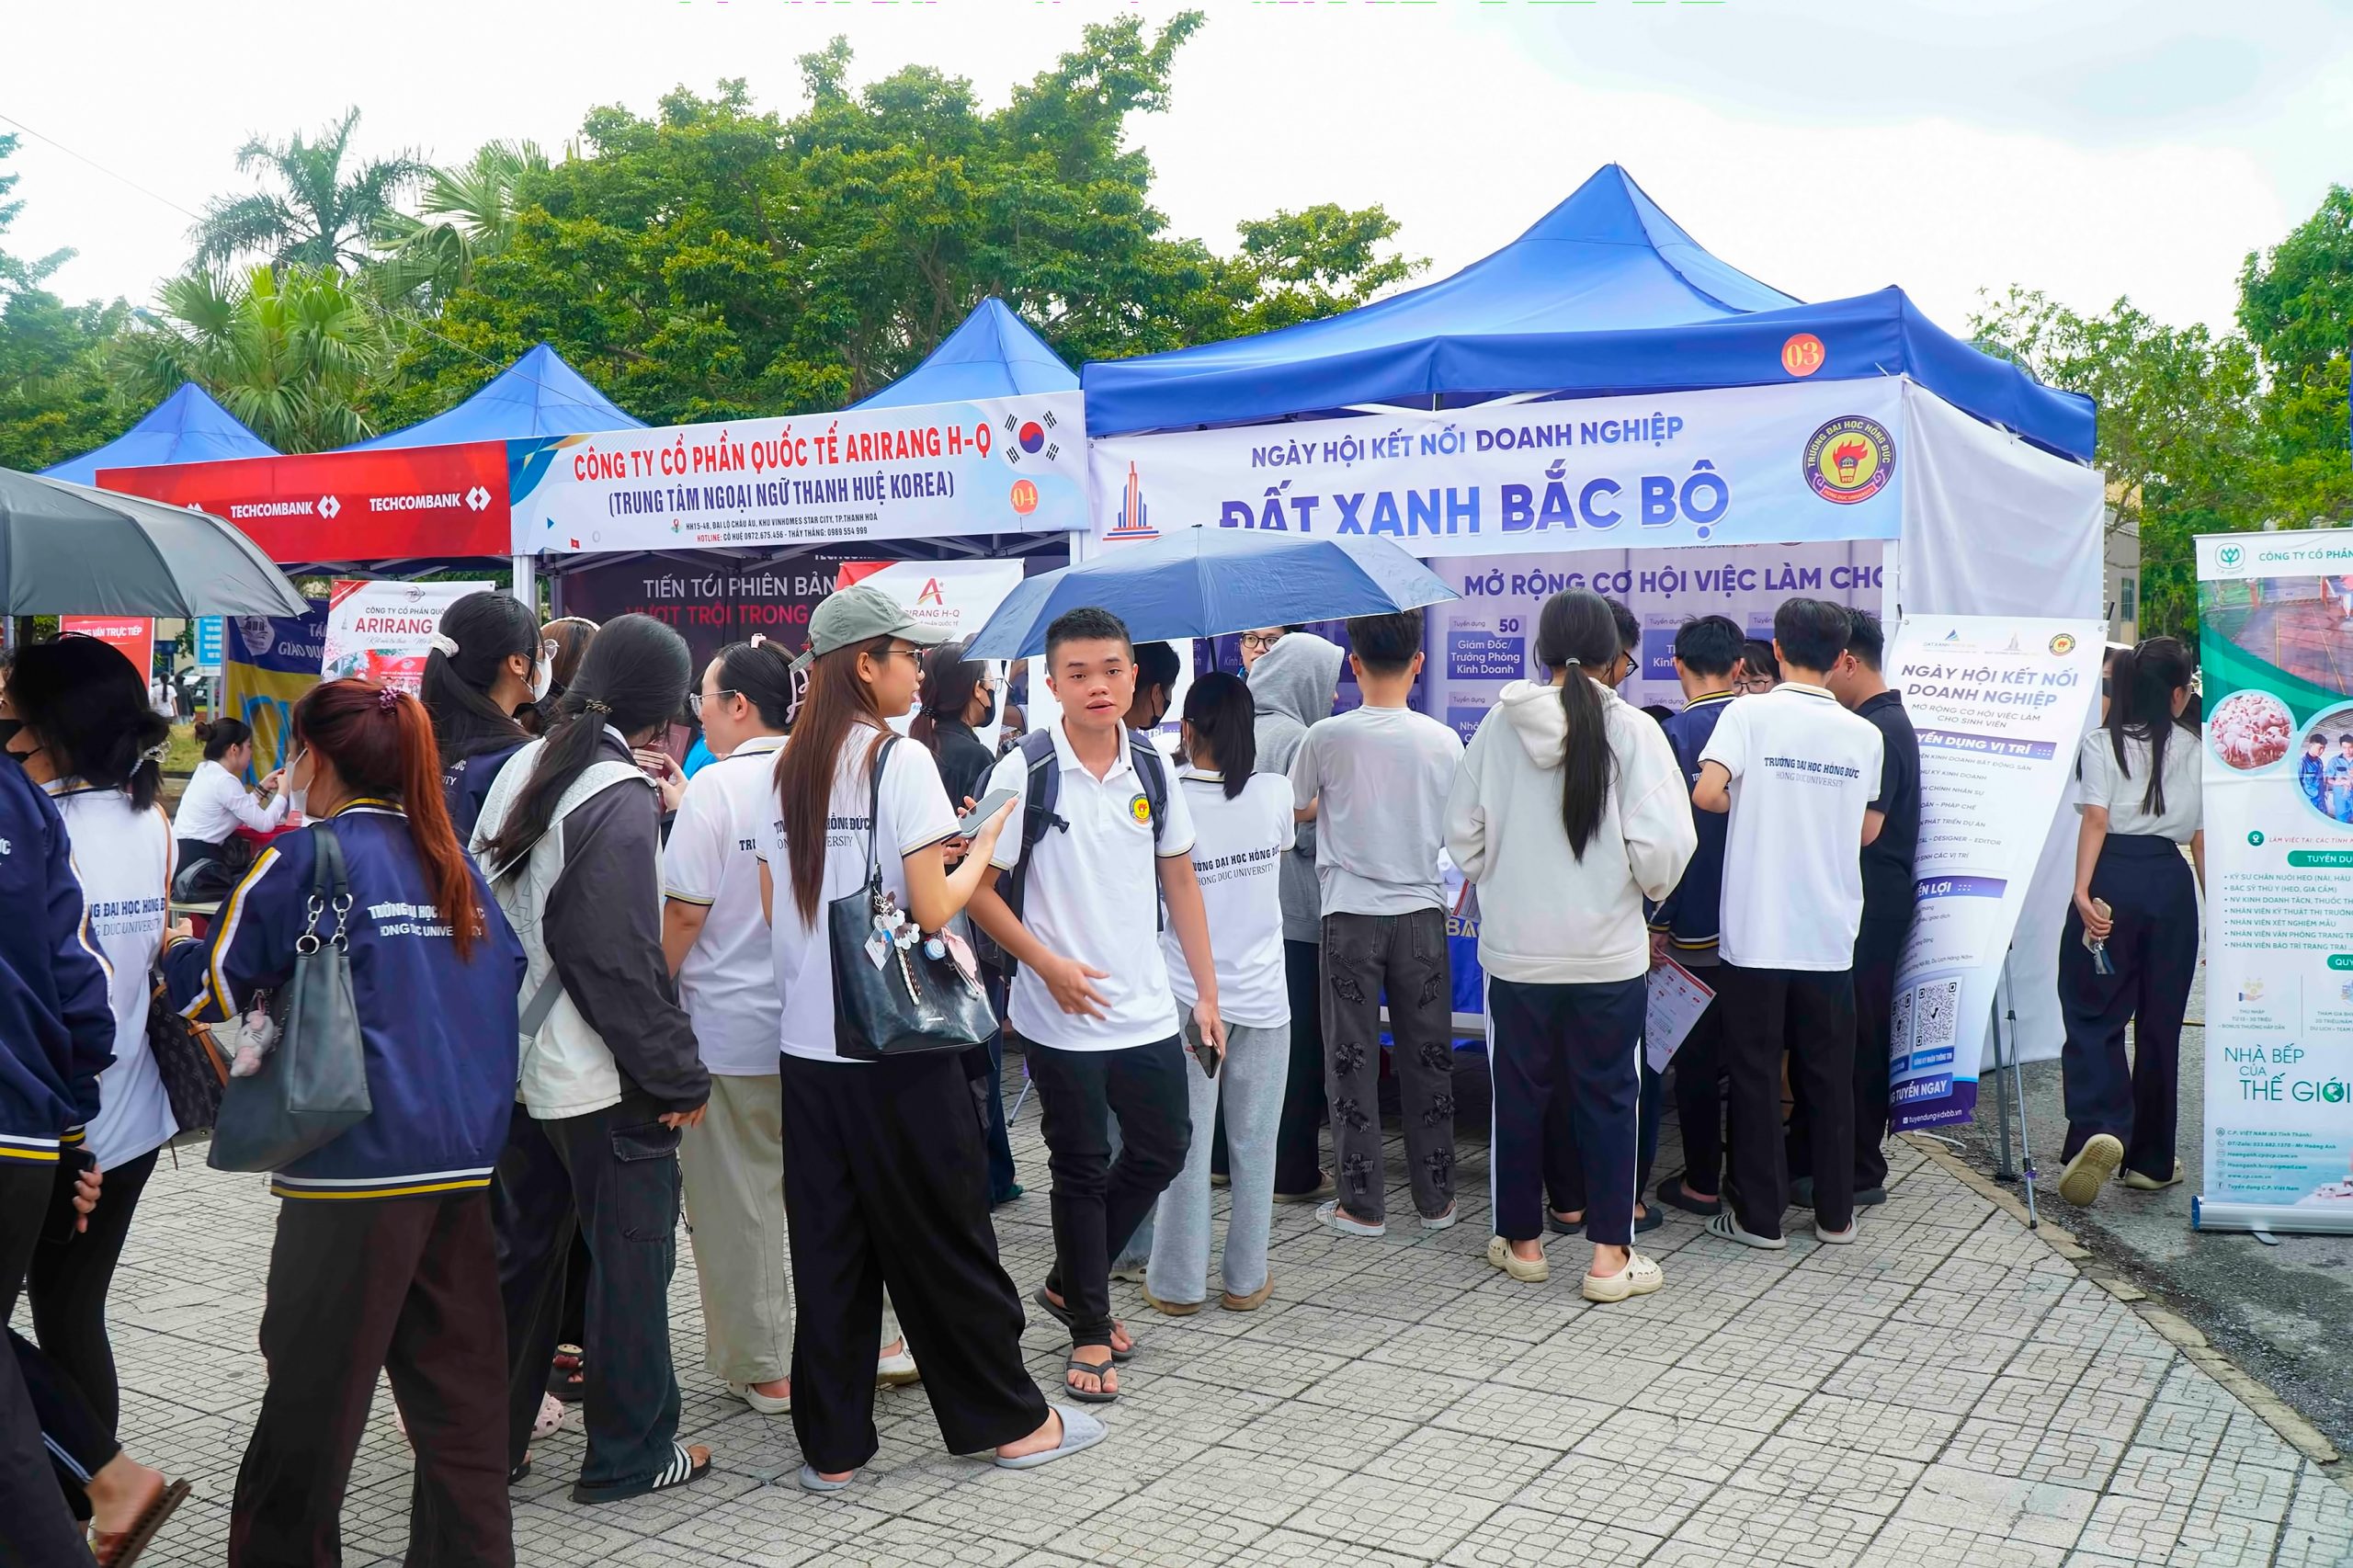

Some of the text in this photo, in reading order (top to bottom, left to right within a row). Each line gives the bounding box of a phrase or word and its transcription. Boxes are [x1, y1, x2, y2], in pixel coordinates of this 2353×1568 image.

[1787, 341, 1820, 369] 03
[1844, 420, 1864, 430] HỌC
[1252, 411, 1684, 468] NGÀY HỘI KẾT NỐI DOANH NGHIỆP
[574, 420, 992, 482] CÔNG TY CỔ PHẦN QUỐC TẾ ARIRANG H-Q
[608, 470, 953, 517] (TRUNG TÂM NGOẠI NGỮ THANH HUỆ KOREA)
[1013, 487, 1037, 507] 04
[1219, 458, 1730, 540] ĐẤT XANH BẮC BỘ
[231, 501, 313, 518] TECHCOMBANK
[369, 493, 460, 512] TECHCOMBANK
[758, 513, 864, 527] KHU VINHOMES STAR CITY, TP.THANH
[697, 533, 722, 543] HOTLINE:
[856, 526, 868, 535] 999
[2258, 551, 2290, 562] CÔNG
[2291, 551, 2305, 561] TY
[2308, 548, 2324, 560] CỔ
[643, 571, 837, 598] TIẾN TỚI PHIÊN BẢN
[1464, 562, 1822, 601] MỞ RỘNG CƠ HỘI VIỆC LÀM
[365, 606, 386, 615] CÔNG
[409, 606, 429, 615] PHẦN
[686, 600, 808, 628] TRỘI TRONG
[942, 609, 960, 618] H-Q
[106, 626, 128, 639] TRỰC
[127, 624, 142, 636] TIẾP
[355, 618, 433, 634] ARIRANG
[1498, 618, 1519, 632] 50
[278, 641, 306, 657] GIÁO
[1458, 638, 1513, 651] Giám Đốc/
[1450, 652, 1520, 664] Trưởng Phòng
[1457, 664, 1514, 674] Kinh Doanh
[1901, 664, 2078, 687] NGÀY HỘI KẾT NỐI
[1907, 683, 2058, 710] DOANH NGHIỆP
[1937, 713, 2007, 729] CHO SINH VIÊN
[1977, 708, 1995, 719] HỘI
[1997, 710, 2019, 721] VIỆC
[1945, 736, 2033, 756] DỤNG VỊ TRÍ
[1764, 756, 1796, 768] TRƯỜNG
[1807, 761, 1822, 774] HỌC
[1823, 761, 1845, 776] HỒNG
[1215, 846, 1271, 869] ĐẠI HỌC HỒNG
[2307, 852, 2336, 863] TUYỂN
[1217, 869, 1233, 882] DUC
[1931, 881, 1952, 896] LỢI
[103, 902, 119, 919] ĐẠI
[121, 900, 141, 917] HỌC
[418, 905, 438, 921] HỌC
[103, 923, 120, 937] DUC
[2224, 1042, 2305, 1064] NHÀ BẾP
[2239, 1062, 2267, 1076] CỦA
[1895, 1079, 1948, 1102] TUYỂN NGAY
[2239, 1072, 2286, 1101] THẾ
